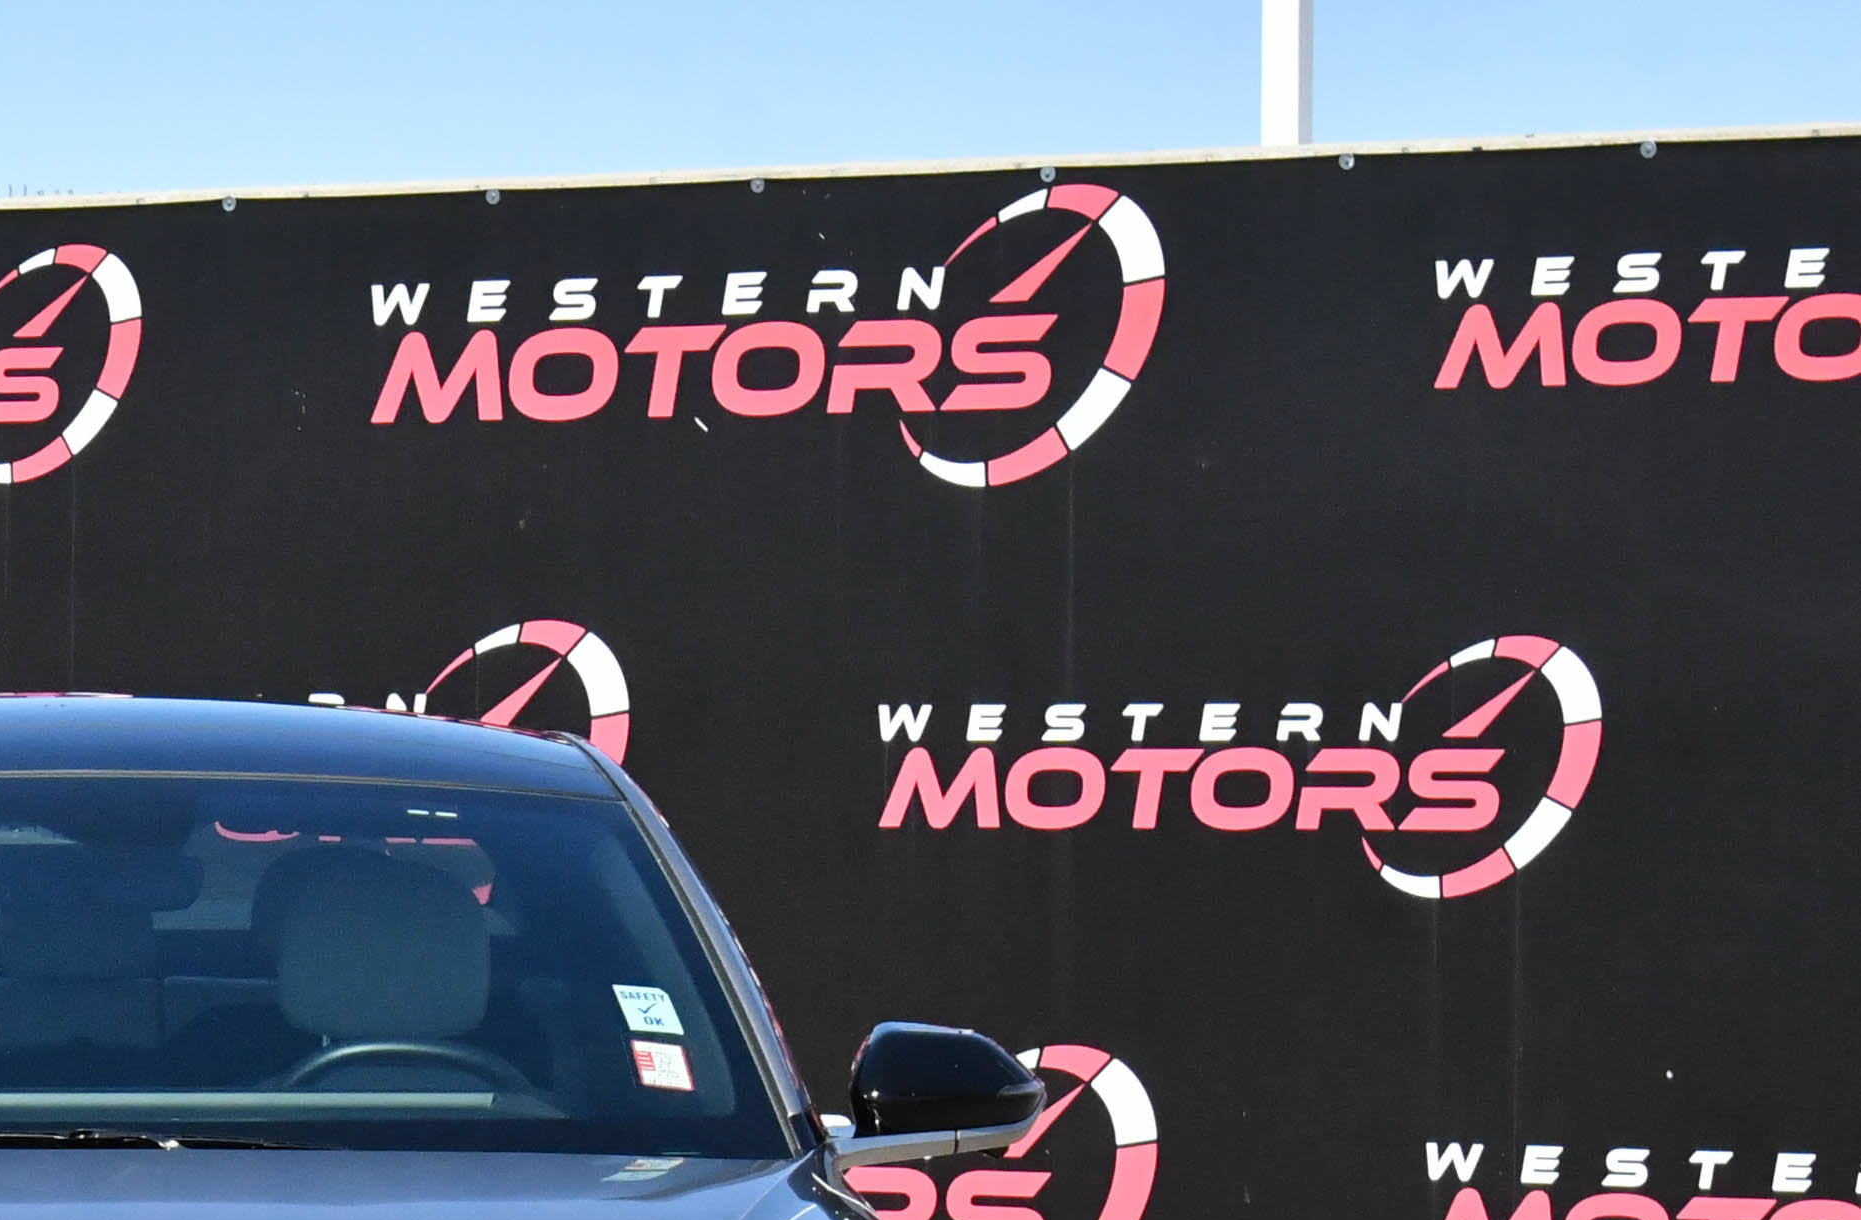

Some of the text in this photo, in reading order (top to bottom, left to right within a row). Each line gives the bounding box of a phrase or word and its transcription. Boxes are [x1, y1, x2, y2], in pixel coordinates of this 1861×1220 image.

[371, 266, 946, 326] WESTERN
[1436, 247, 1830, 299] WESTE
[1434, 293, 1861, 389] MOTO
[370, 313, 1059, 424] MOTORS
[877, 703, 1403, 743] WESTERN
[878, 747, 1505, 831] MOTORS
[620, 991, 665, 1003] SAFETY
[643, 1016, 665, 1026] OK
[1426, 1142, 1861, 1195] WESTE
